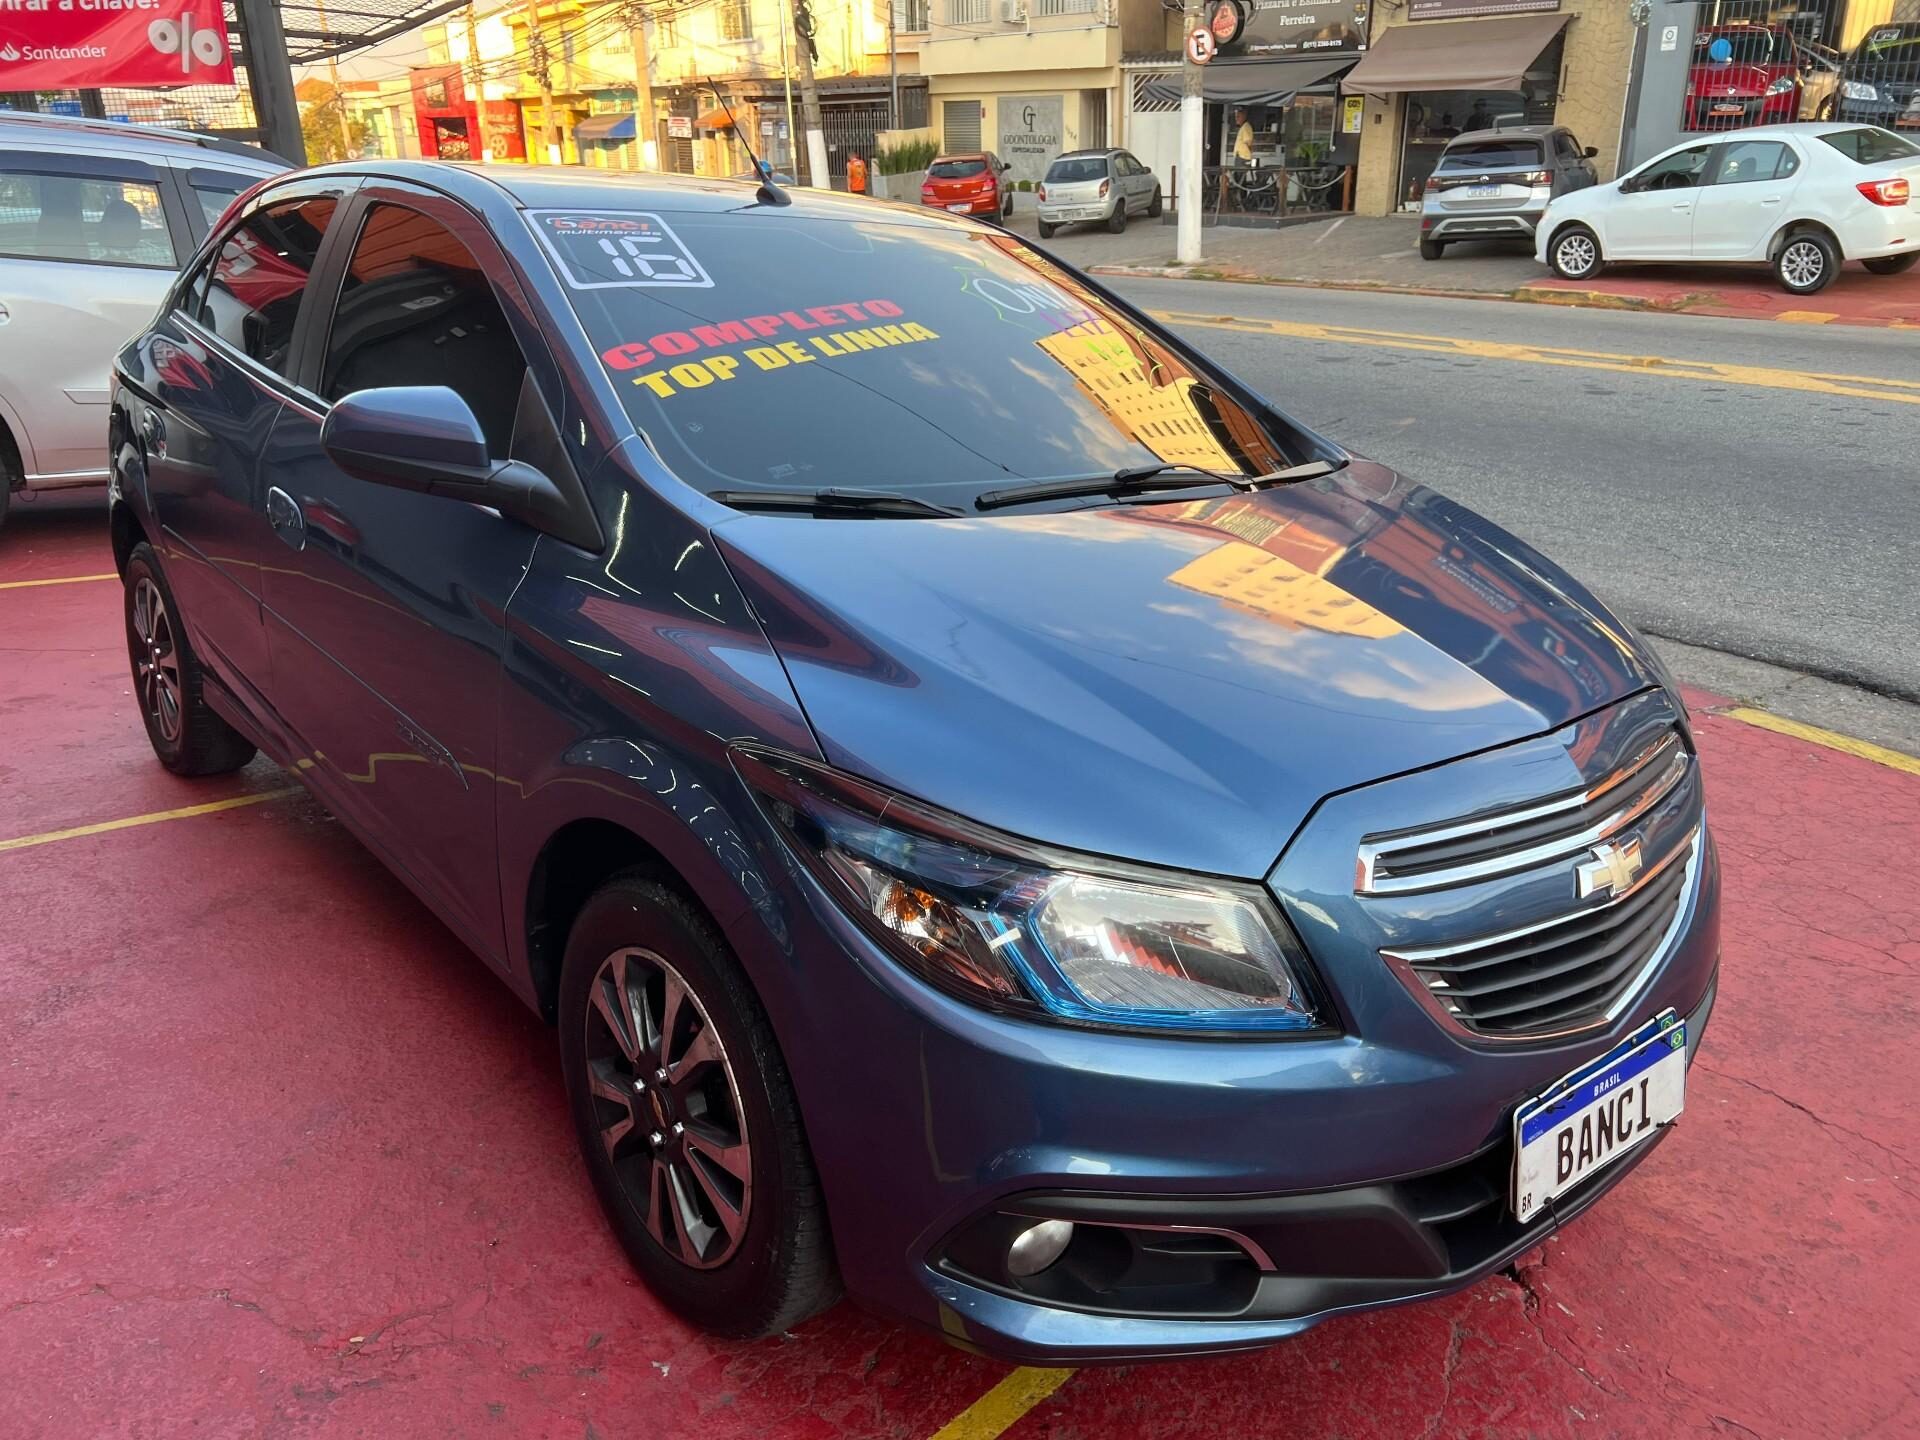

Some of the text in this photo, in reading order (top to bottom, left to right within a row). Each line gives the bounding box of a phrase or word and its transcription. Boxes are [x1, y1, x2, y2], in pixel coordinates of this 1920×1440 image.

[0, 0, 48, 10] irar
[1279, 14, 1316, 26] Ferreira
[22, 45, 107, 61] Santander
[1003, 134, 1057, 145] ODONTOLOGIA
[553, 218, 649, 231] banci
[597, 236, 697, 281] 16
[600, 299, 904, 371] COMPLETO
[632, 321, 941, 399] TOP DE LINHA
[1593, 1072, 1621, 1097] BRASIL
[1556, 1077, 1651, 1186] BANCI
[1521, 1192, 1532, 1214] BR
